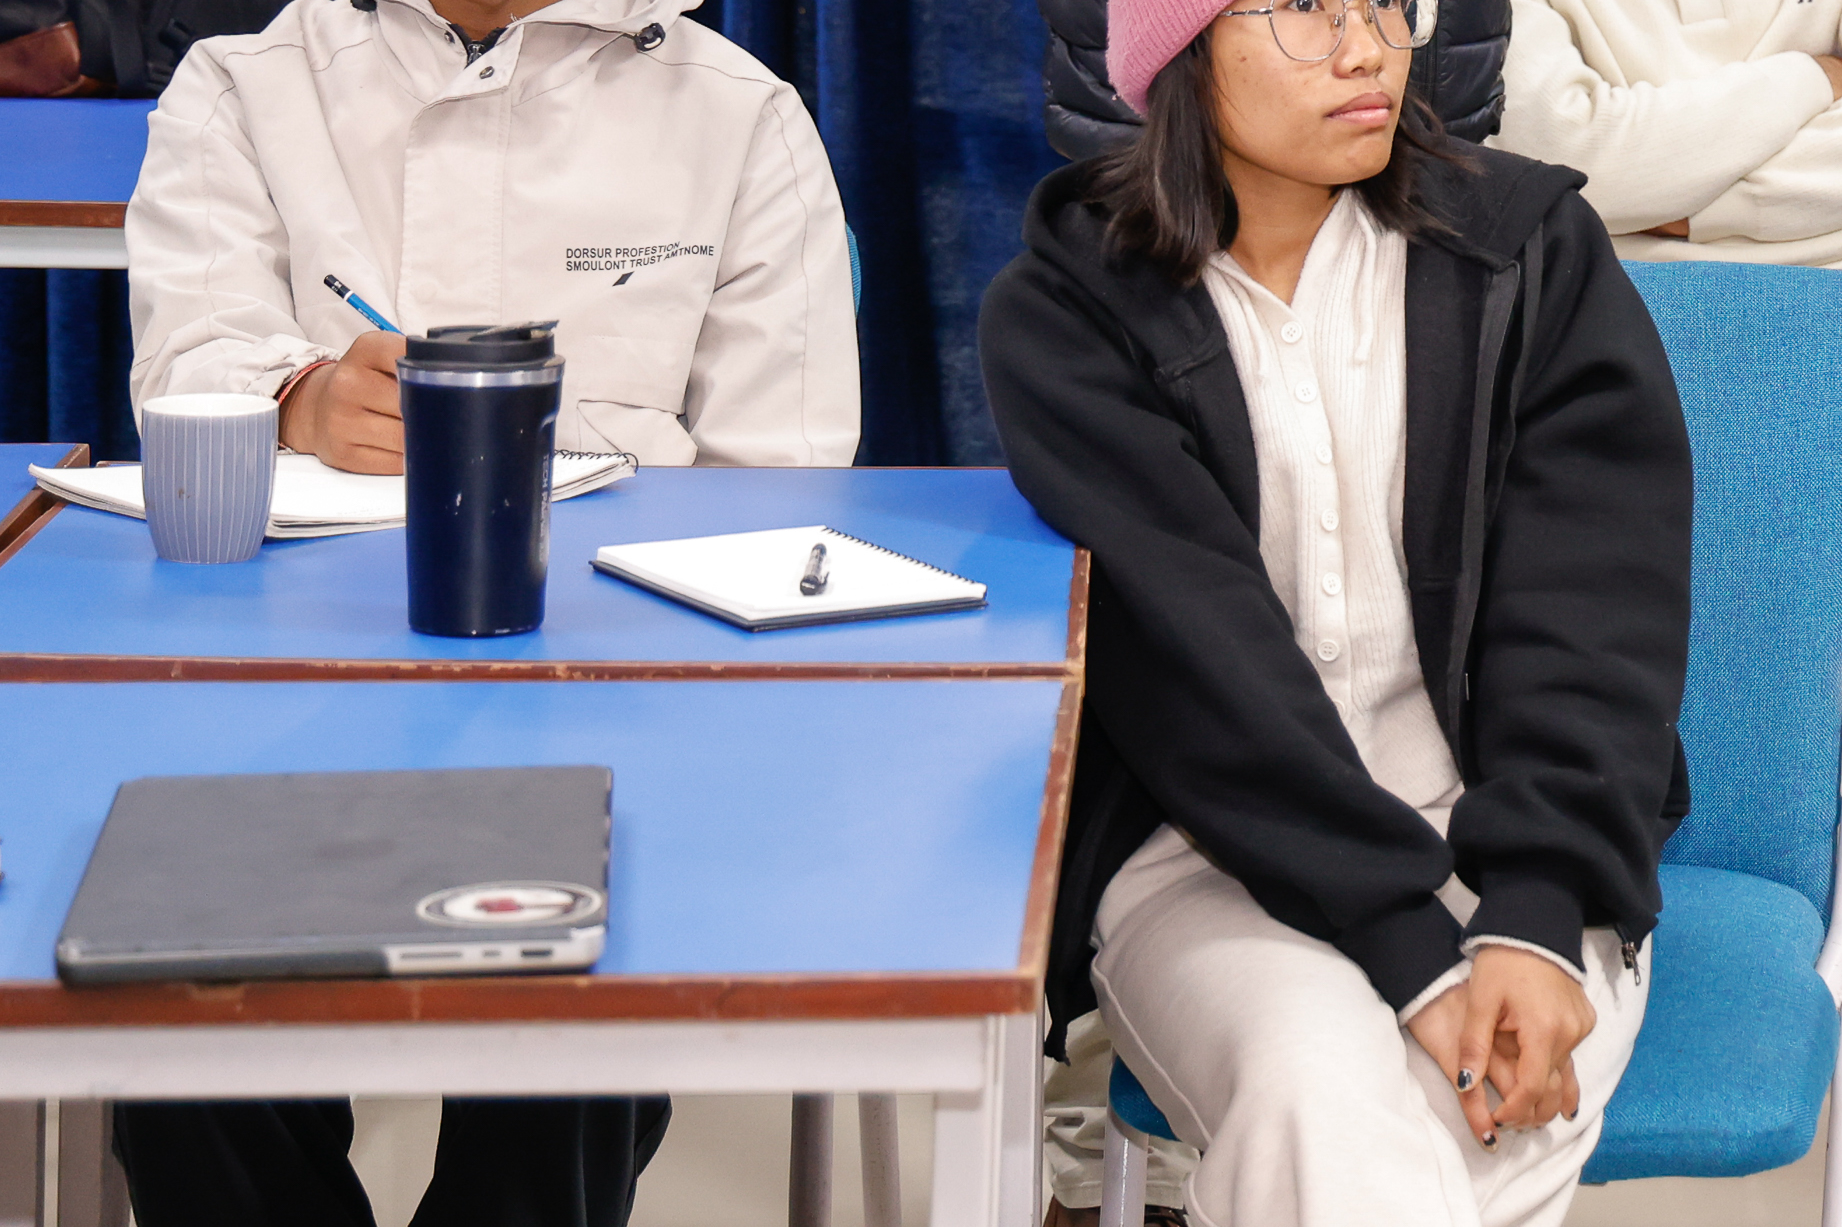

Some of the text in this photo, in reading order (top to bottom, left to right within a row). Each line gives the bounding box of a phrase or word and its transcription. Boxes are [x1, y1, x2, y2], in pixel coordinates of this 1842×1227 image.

[566, 241, 681, 259] DORSUR PROFESTION
[566, 245, 715, 272] SMOULONT TRUST AMTNOME
